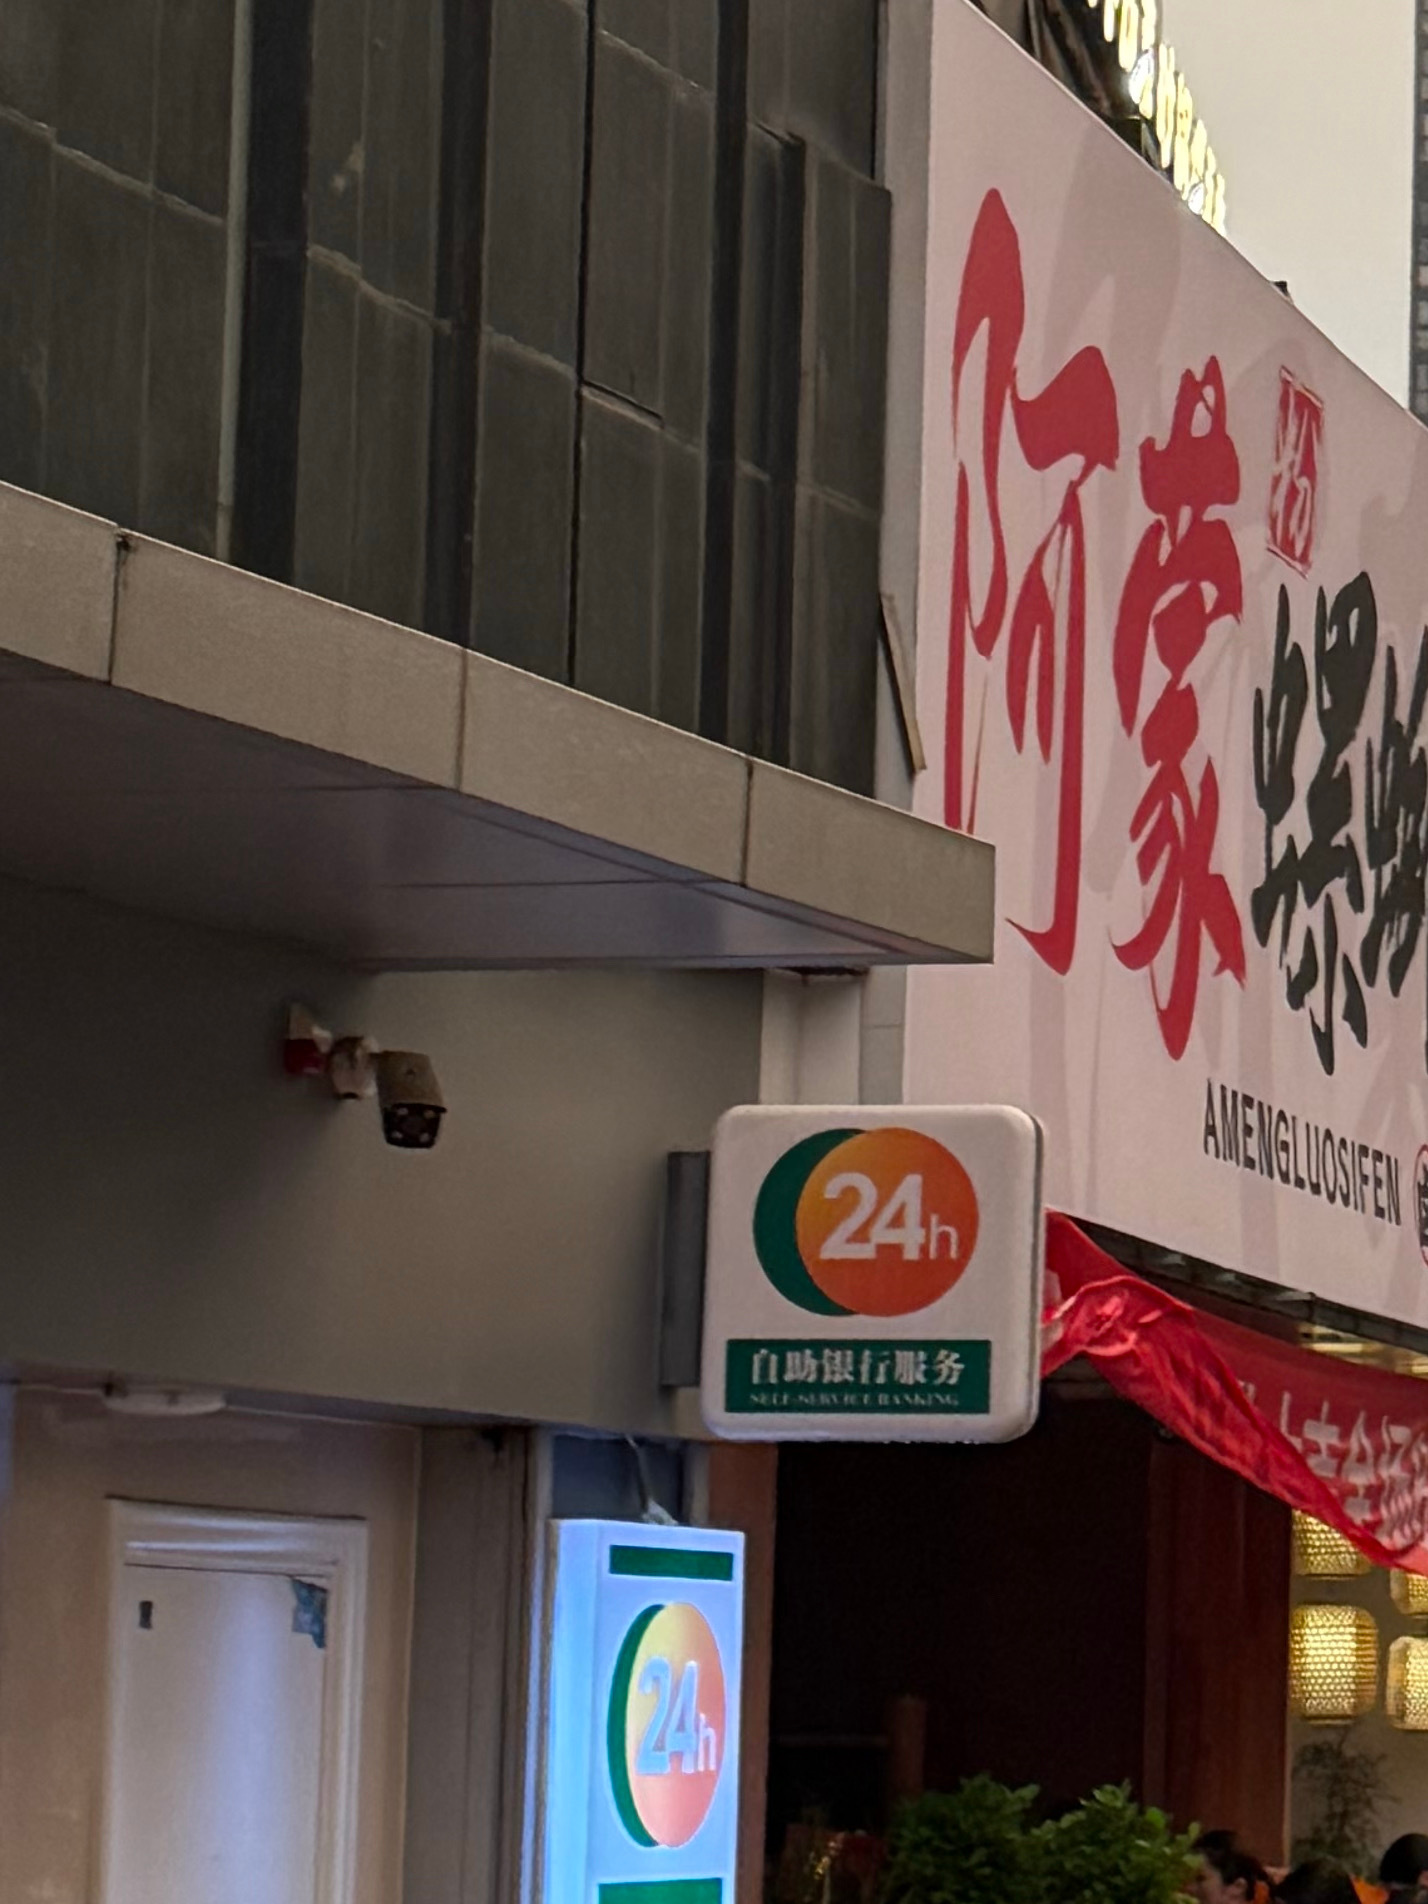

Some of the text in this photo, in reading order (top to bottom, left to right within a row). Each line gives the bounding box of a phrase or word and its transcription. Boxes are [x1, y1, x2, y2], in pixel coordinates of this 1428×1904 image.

[1203, 1077, 1402, 1226] AMENGLUOSIFEN
[818, 1171, 959, 1262] 24h
[752, 1348, 965, 1386] 自助银行服务
[635, 1654, 718, 1775] 24h
